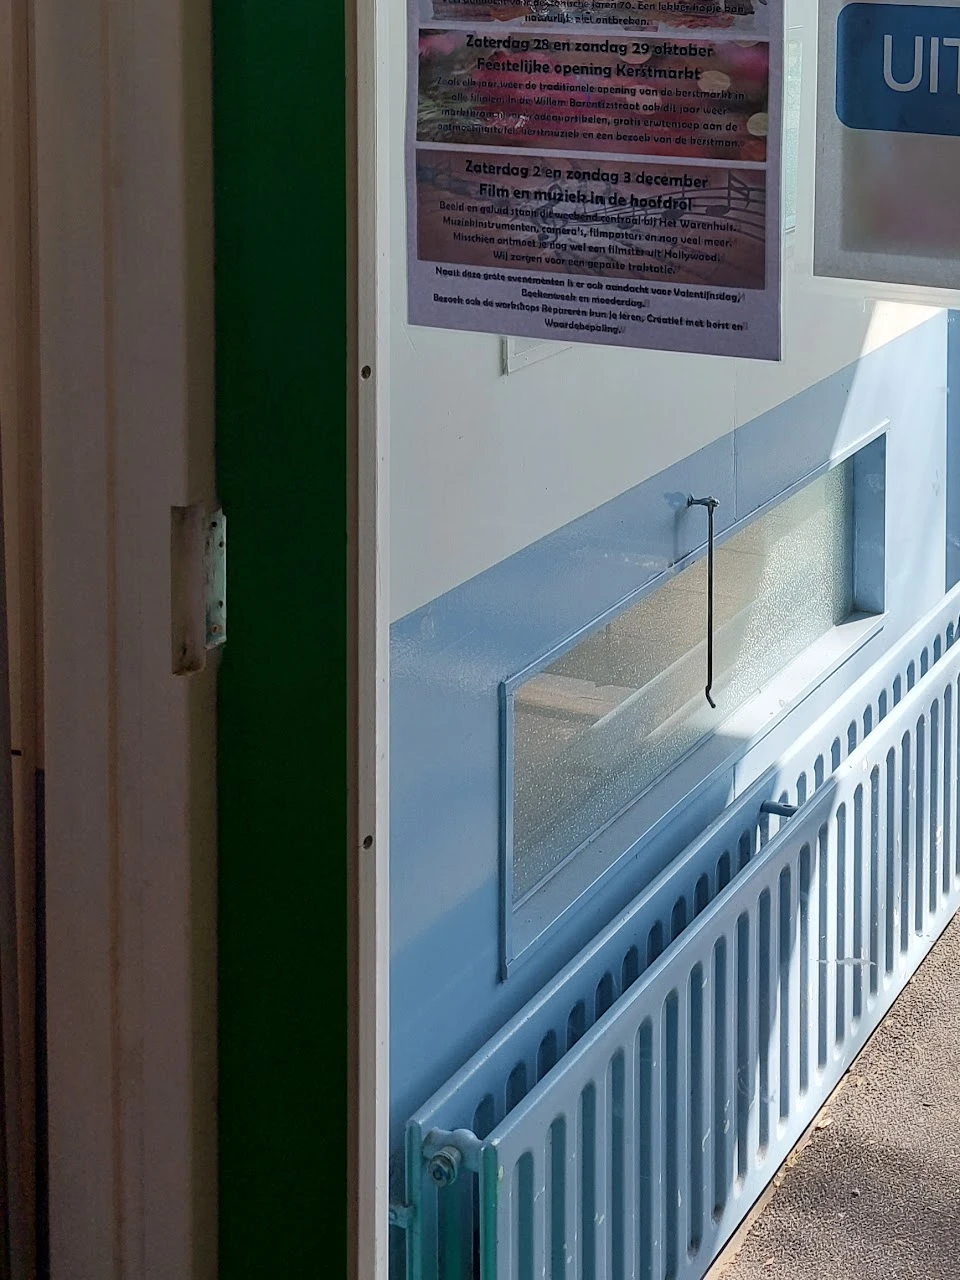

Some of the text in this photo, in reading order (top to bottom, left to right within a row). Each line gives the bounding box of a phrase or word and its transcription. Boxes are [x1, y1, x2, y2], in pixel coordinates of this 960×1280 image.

[466, 34, 714, 57] Zaterdag 28 en zondag 29 oktober
[477, 58, 701, 80] Feestelijke opening Kerstmarkt
[465, 159, 709, 189] Zaterdag 2 en zondag 3 december
[479, 183, 692, 212] Film en muziek in de hoofdrol
